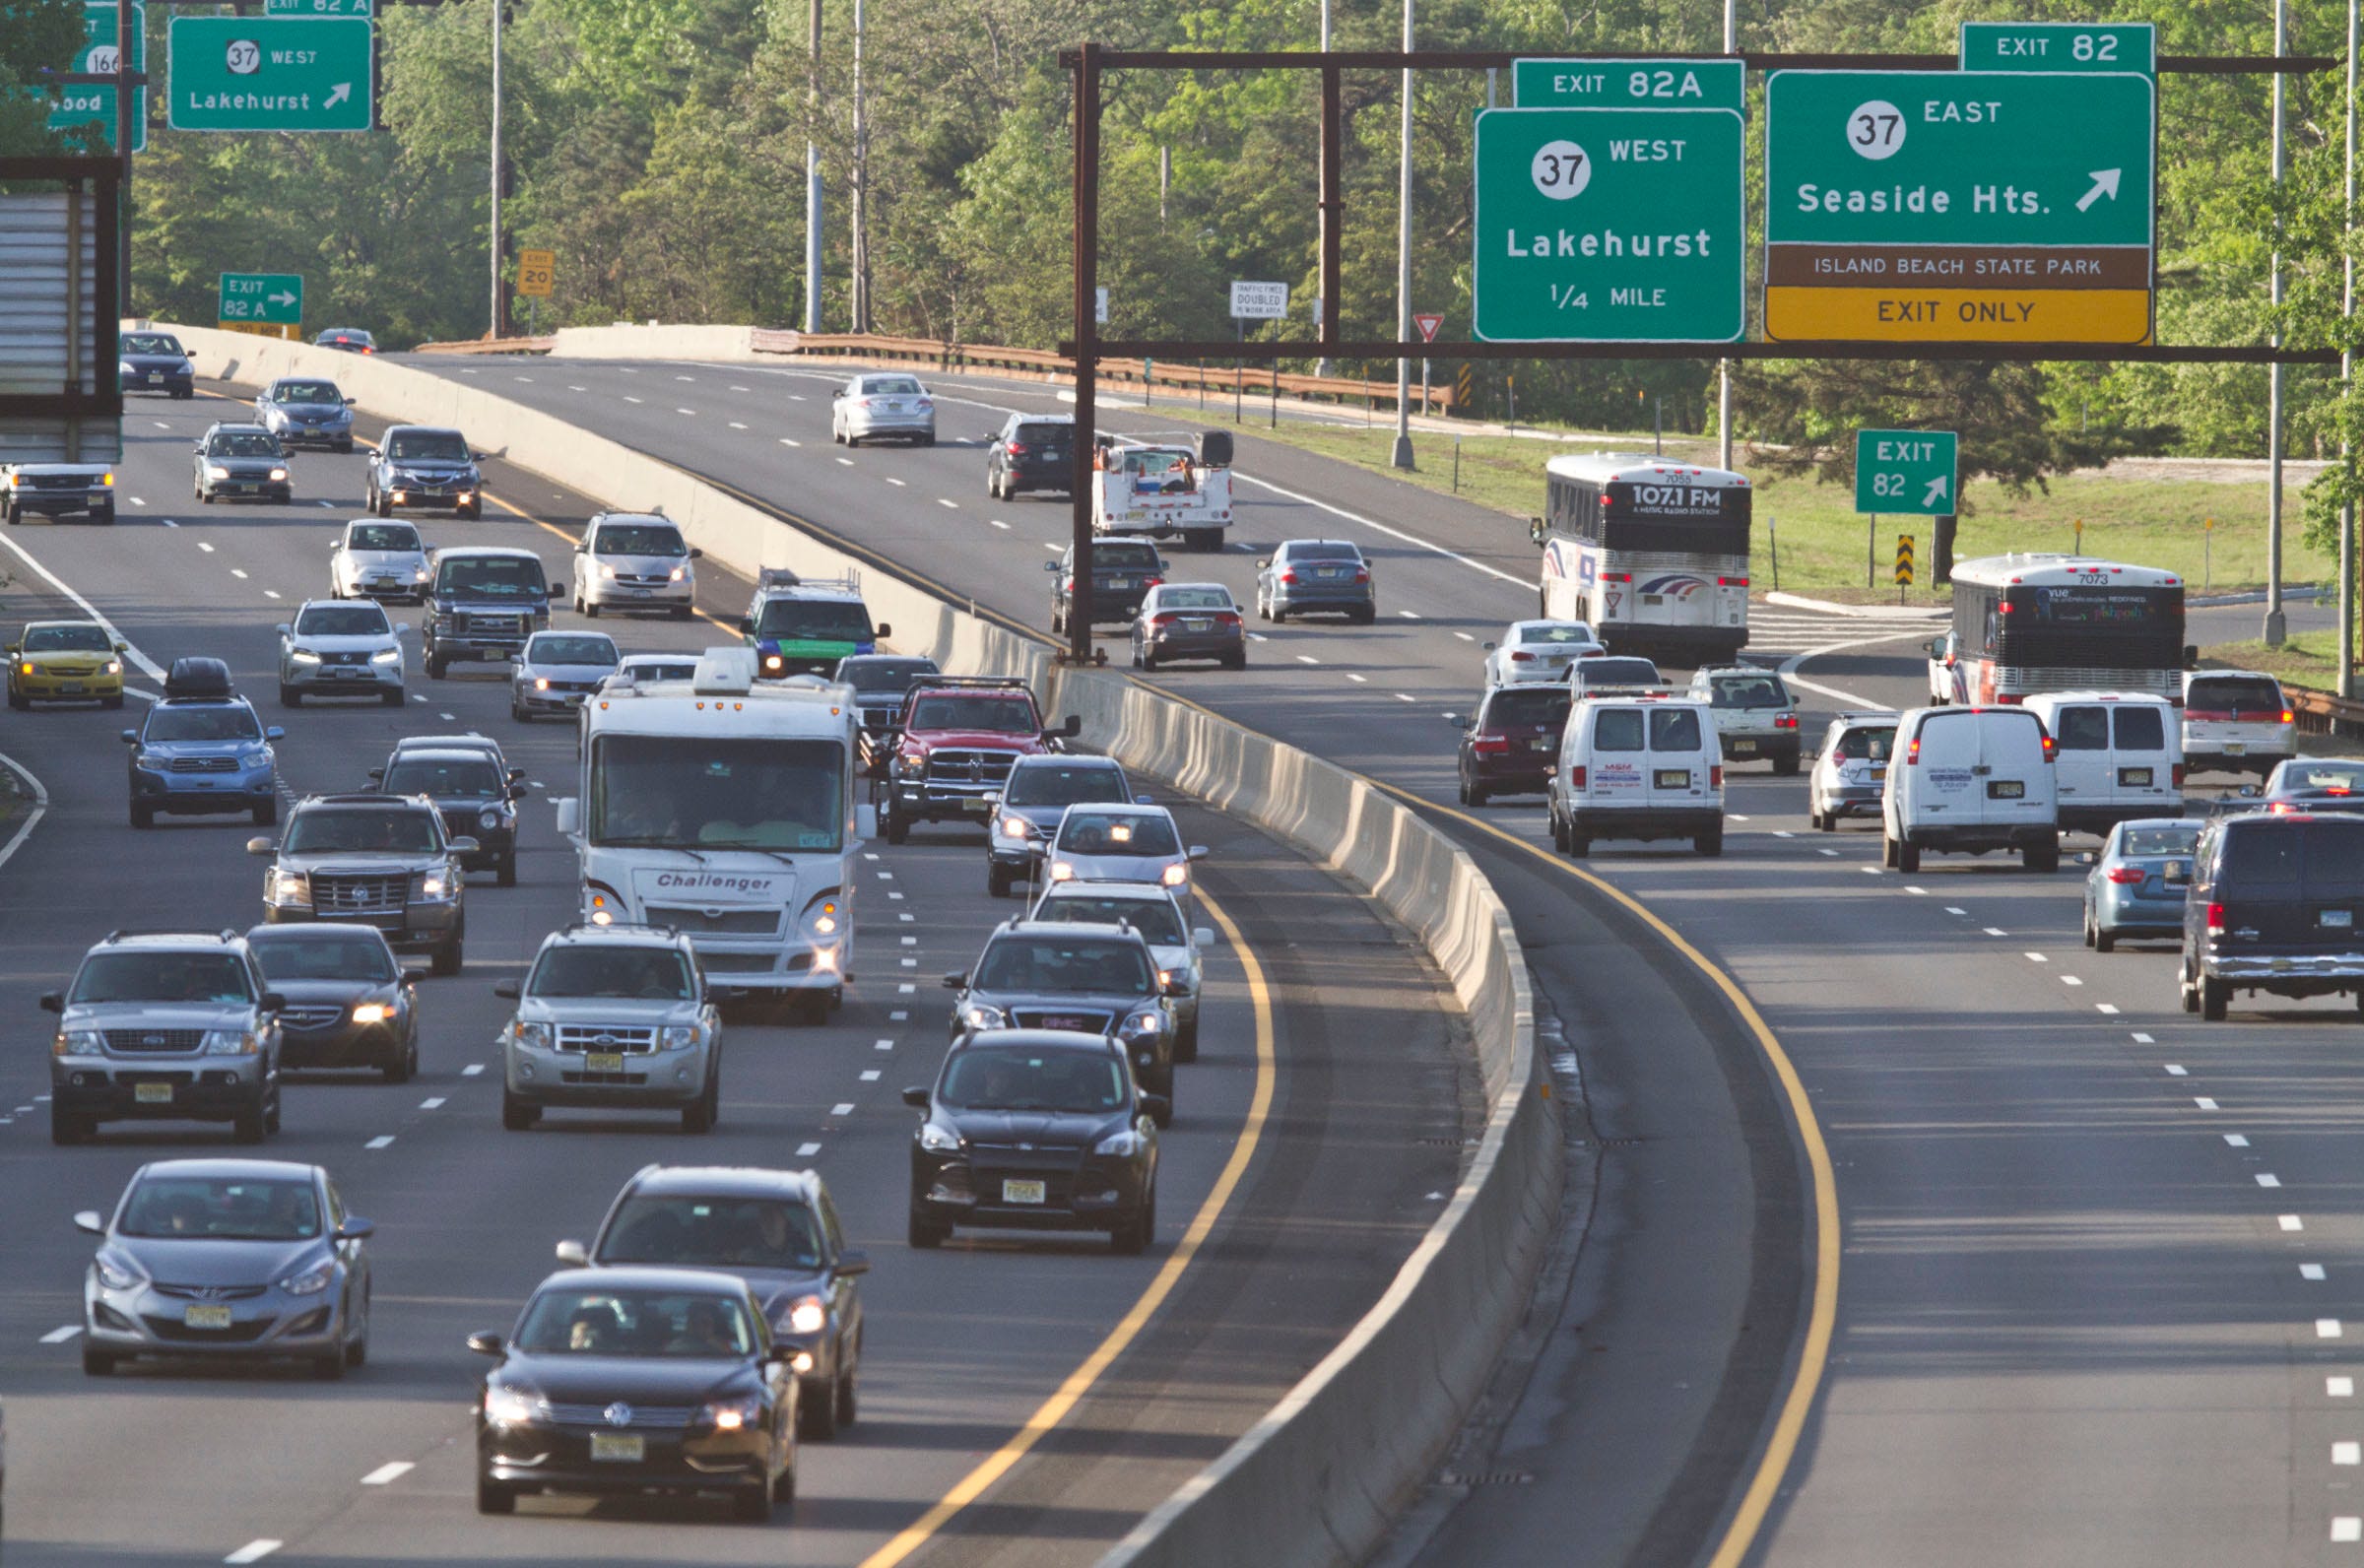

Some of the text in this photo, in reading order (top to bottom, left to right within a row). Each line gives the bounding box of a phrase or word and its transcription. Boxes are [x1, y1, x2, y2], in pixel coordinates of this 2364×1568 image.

[230, 47, 256, 66] 37
[270, 50, 317, 64] WEST
[1997, 34, 2119, 61] EXIT 82
[1552, 71, 1703, 98] EXIT 82A
[190, 92, 310, 110] Lakehurst
[1924, 100, 2003, 122] EAST
[1855, 114, 1899, 146] 37
[1609, 140, 1687, 162] WEST
[1540, 154, 1584, 187] 37
[1798, 183, 2051, 215] Seaside Hts.
[1507, 229, 1711, 257] Lakehurst
[1814, 258, 2101, 275] ISLAND BEACH STATE PARK
[525, 270, 548, 284] 20
[229, 280, 264, 294] EXIT
[1237, 294, 1280, 305] DOUBLED
[1610, 288, 1667, 306] MILE
[224, 299, 266, 317] 82 A
[1878, 301, 2036, 322] EXIT ONLY
[1876, 440, 1936, 462] EXIT
[1665, 474, 1692, 484] 7055
[1872, 473, 1906, 496] 82
[1633, 486, 1721, 506] 107.1 FM
[2078, 573, 2109, 585] 7073
[656, 874, 772, 891] Challenger
